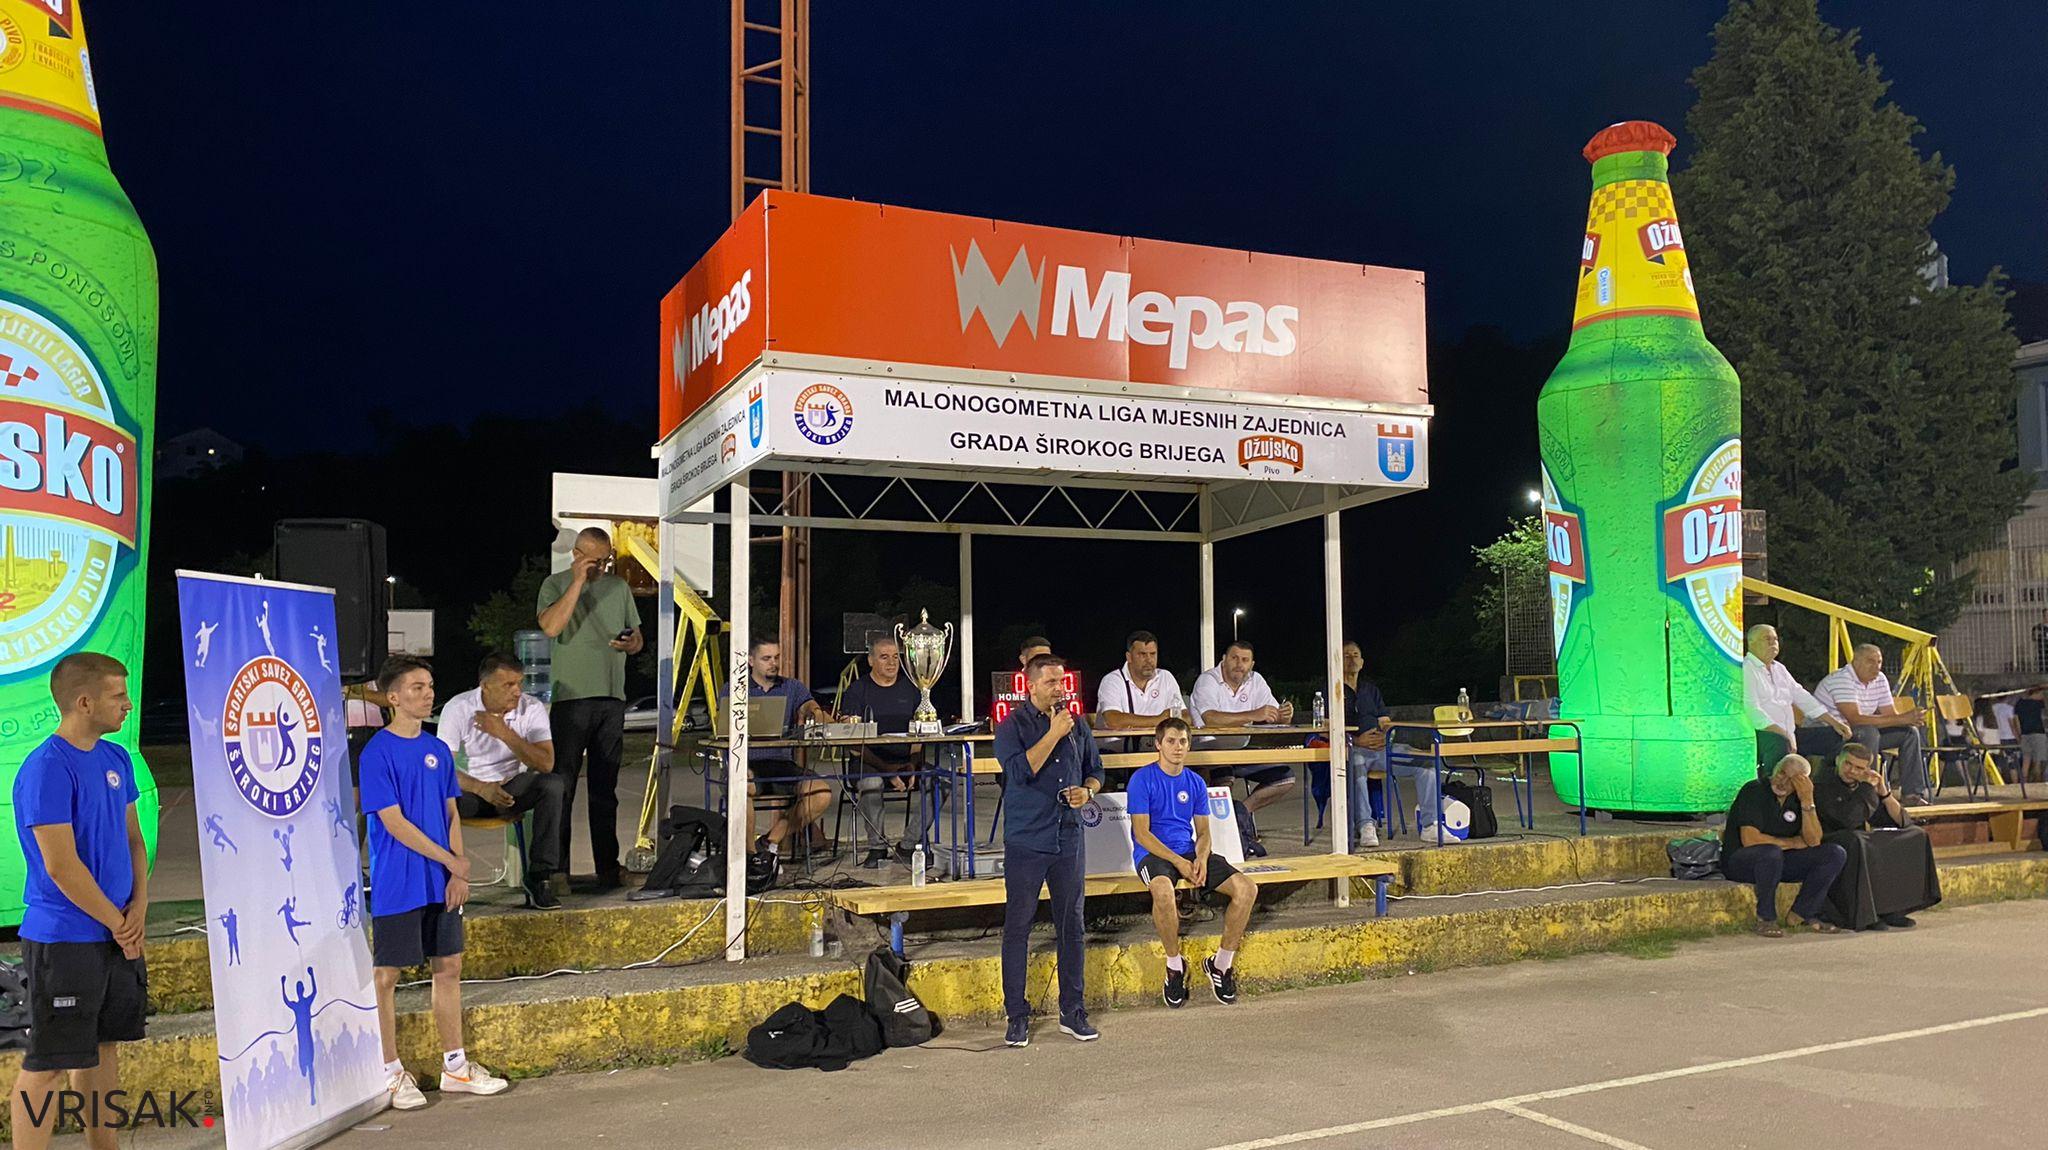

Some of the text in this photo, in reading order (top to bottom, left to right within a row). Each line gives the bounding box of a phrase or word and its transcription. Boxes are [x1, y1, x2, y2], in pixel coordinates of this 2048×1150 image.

[691, 268, 752, 373] Mepas
[1050, 264, 1299, 370] Mepas
[51, 348, 92, 397] LAGER
[825, 419, 852, 443] BRIJEG
[885, 389, 1346, 438] MALONOGOMETNA LIGA MJESNIH ZAJEDNICA
[950, 431, 1226, 464] GRADA ŠIROKOG BRIJEGA
[77, 557, 106, 603] PIVO
[261, 662, 291, 685] SAVEZ
[291, 680, 317, 729] GRADA
[998, 693, 1026, 701] HOME
[229, 744, 321, 811] ŠIROKI BRIJEG
